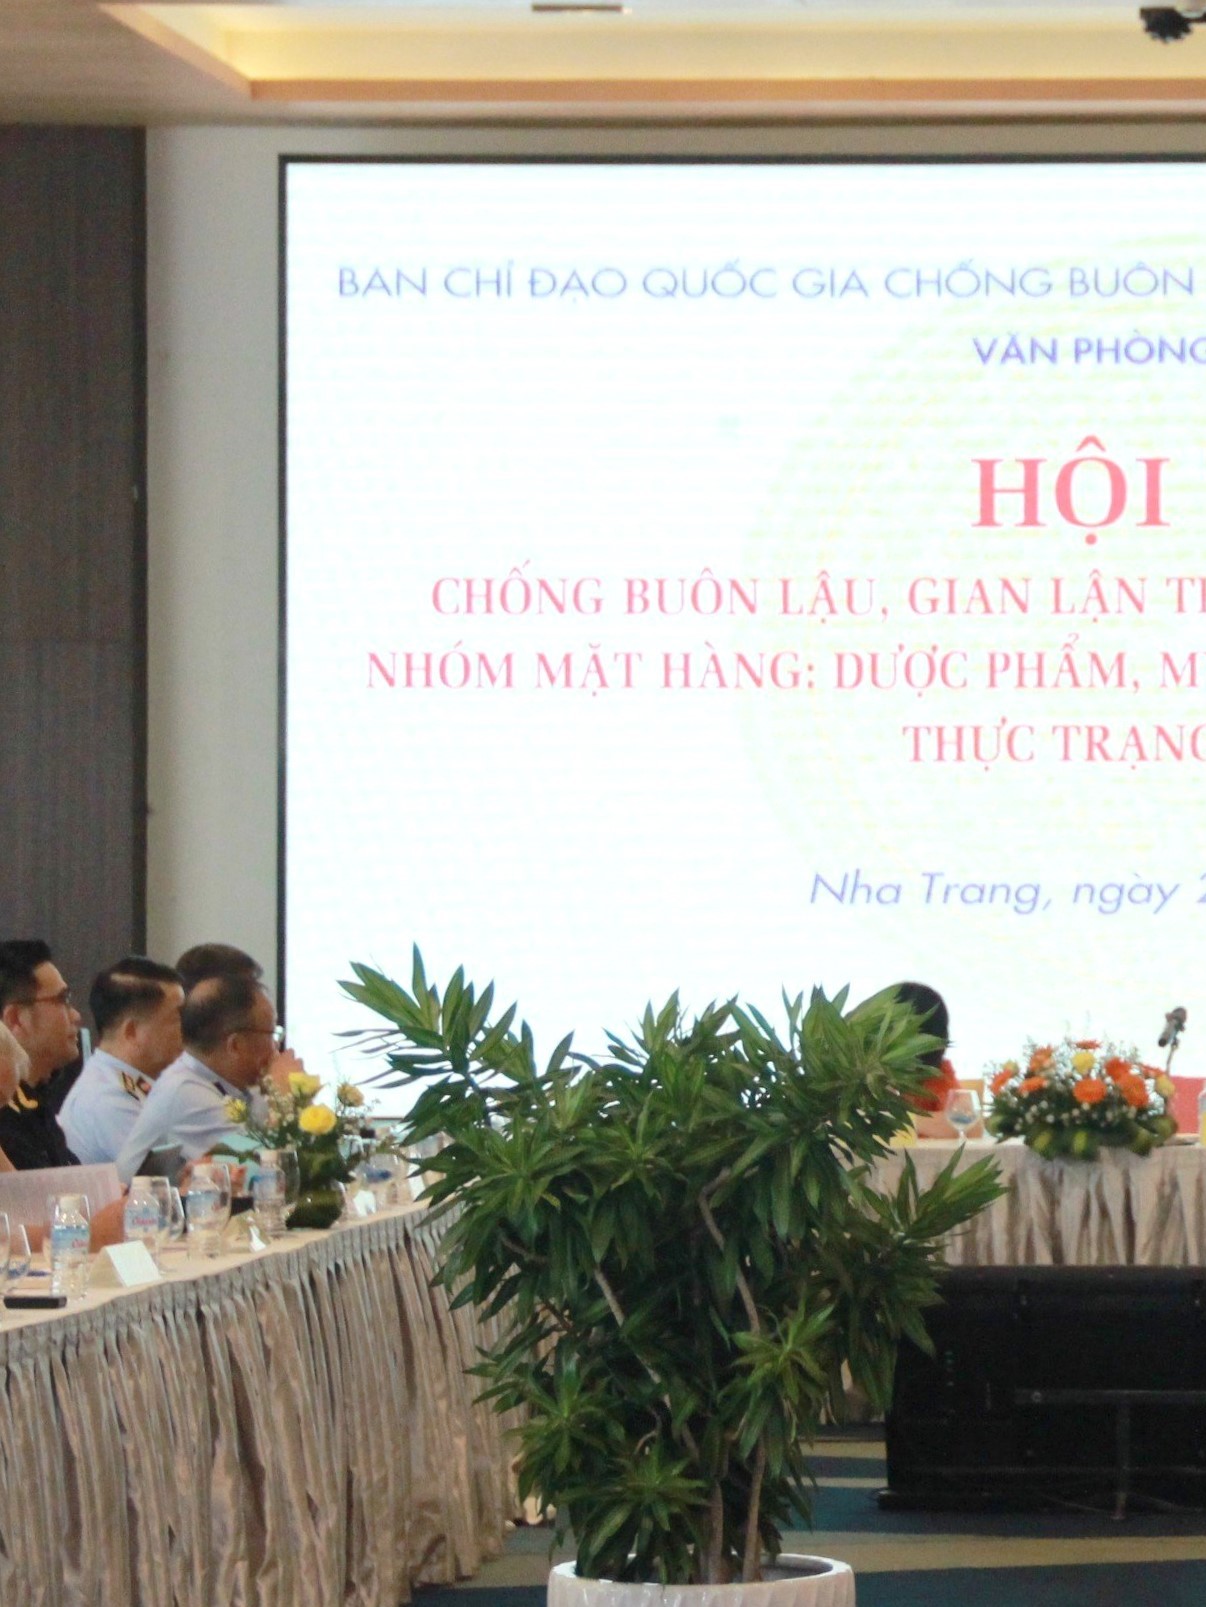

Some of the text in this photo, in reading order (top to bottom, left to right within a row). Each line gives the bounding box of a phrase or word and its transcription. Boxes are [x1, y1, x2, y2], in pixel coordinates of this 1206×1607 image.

[335, 262, 429, 300] BAN
[440, 258, 516, 299] CHỈ
[526, 265, 629, 304] ĐẠO
[640, 257, 778, 300] QUỐC
[790, 264, 871, 301] GIA
[883, 257, 1055, 300] CHỐNG
[1067, 260, 1196, 299] BUÔN
[971, 330, 1059, 367] VĂN
[970, 433, 1171, 547] HỘI
[431, 559, 604, 615] CHỐNG
[625, 566, 759, 616] BUÔN
[779, 569, 889, 625] LẬU,
[907, 576, 1031, 616] GIAN
[1051, 568, 1147, 624] LẬN
[367, 640, 514, 689] NHÓM
[536, 643, 643, 698] MẶT
[662, 640, 815, 690] HÀNG:
[834, 642, 968, 698] DƯỢC
[987, 633, 1141, 693] PHẨM,
[901, 715, 1035, 772] THỰC
[809, 867, 903, 907] Nha
[921, 871, 1053, 916] Trang,
[1071, 871, 1182, 916] ngày
